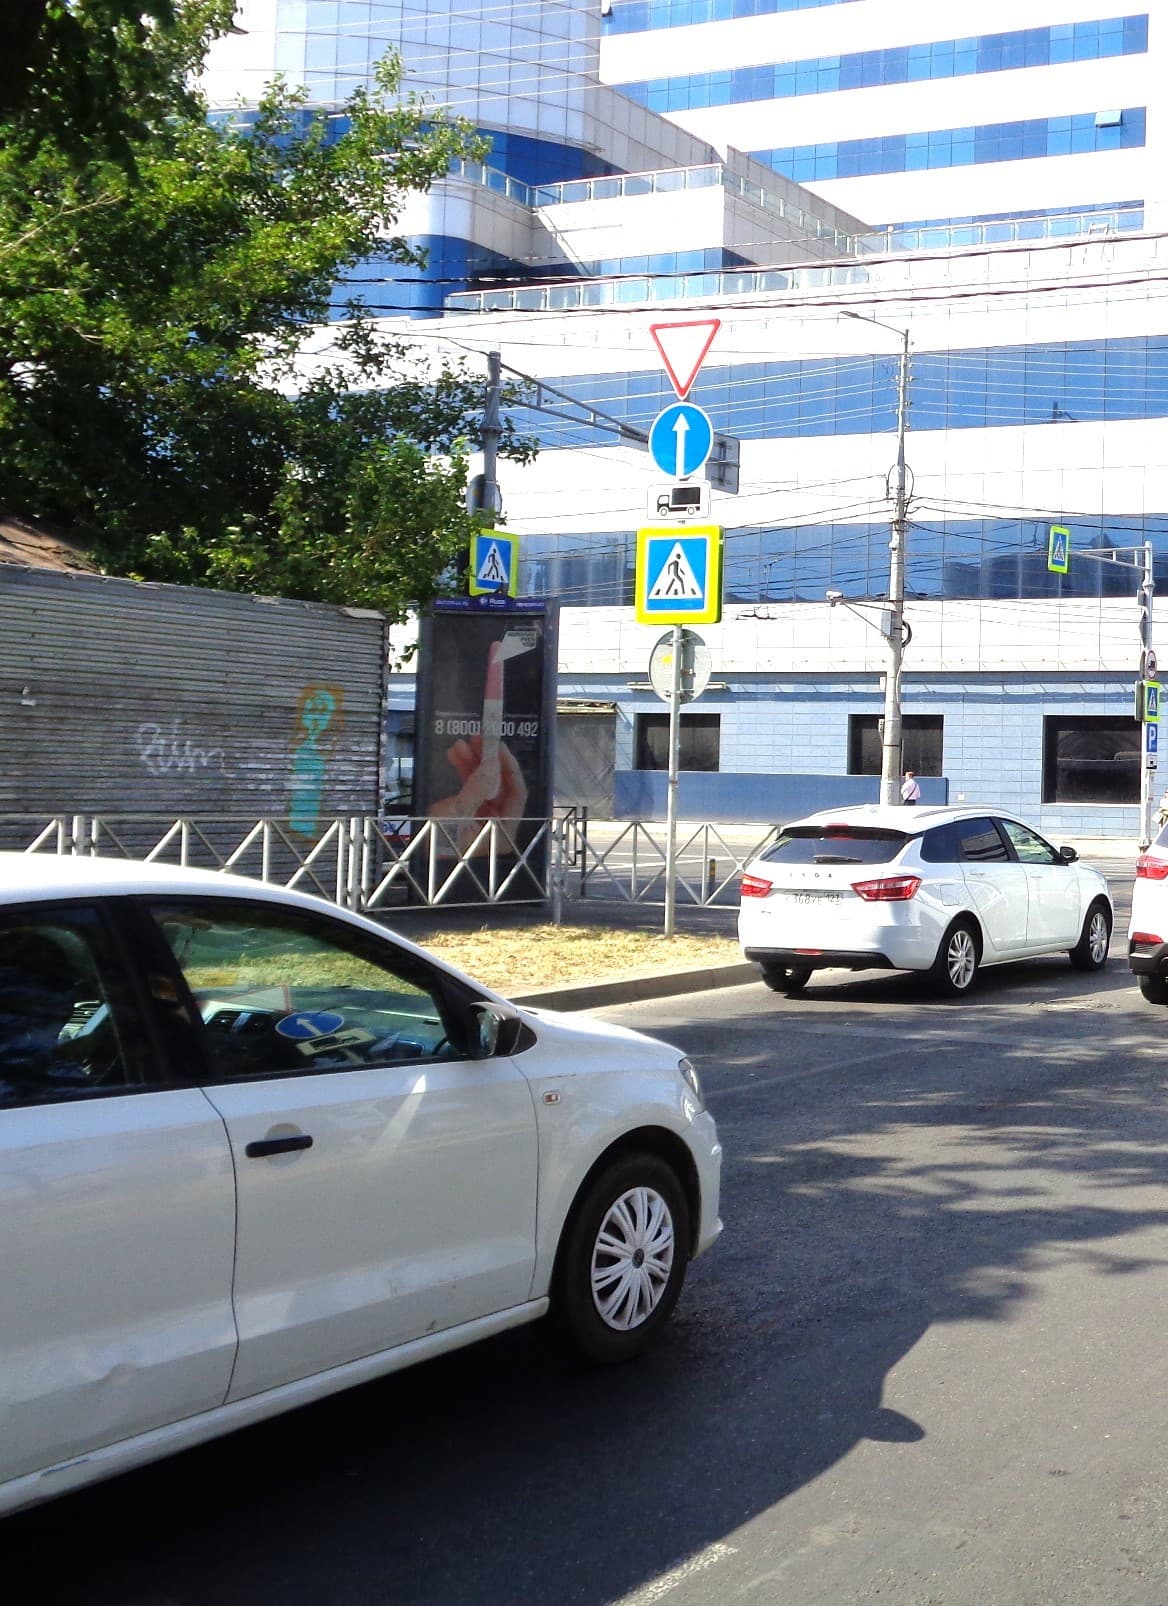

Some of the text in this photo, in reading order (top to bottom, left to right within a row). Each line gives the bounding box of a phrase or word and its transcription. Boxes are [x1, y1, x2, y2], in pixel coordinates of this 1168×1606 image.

[434, 719, 444, 735] 8
[516, 721, 539, 737] 492
[1149, 726, 1156, 750] P
